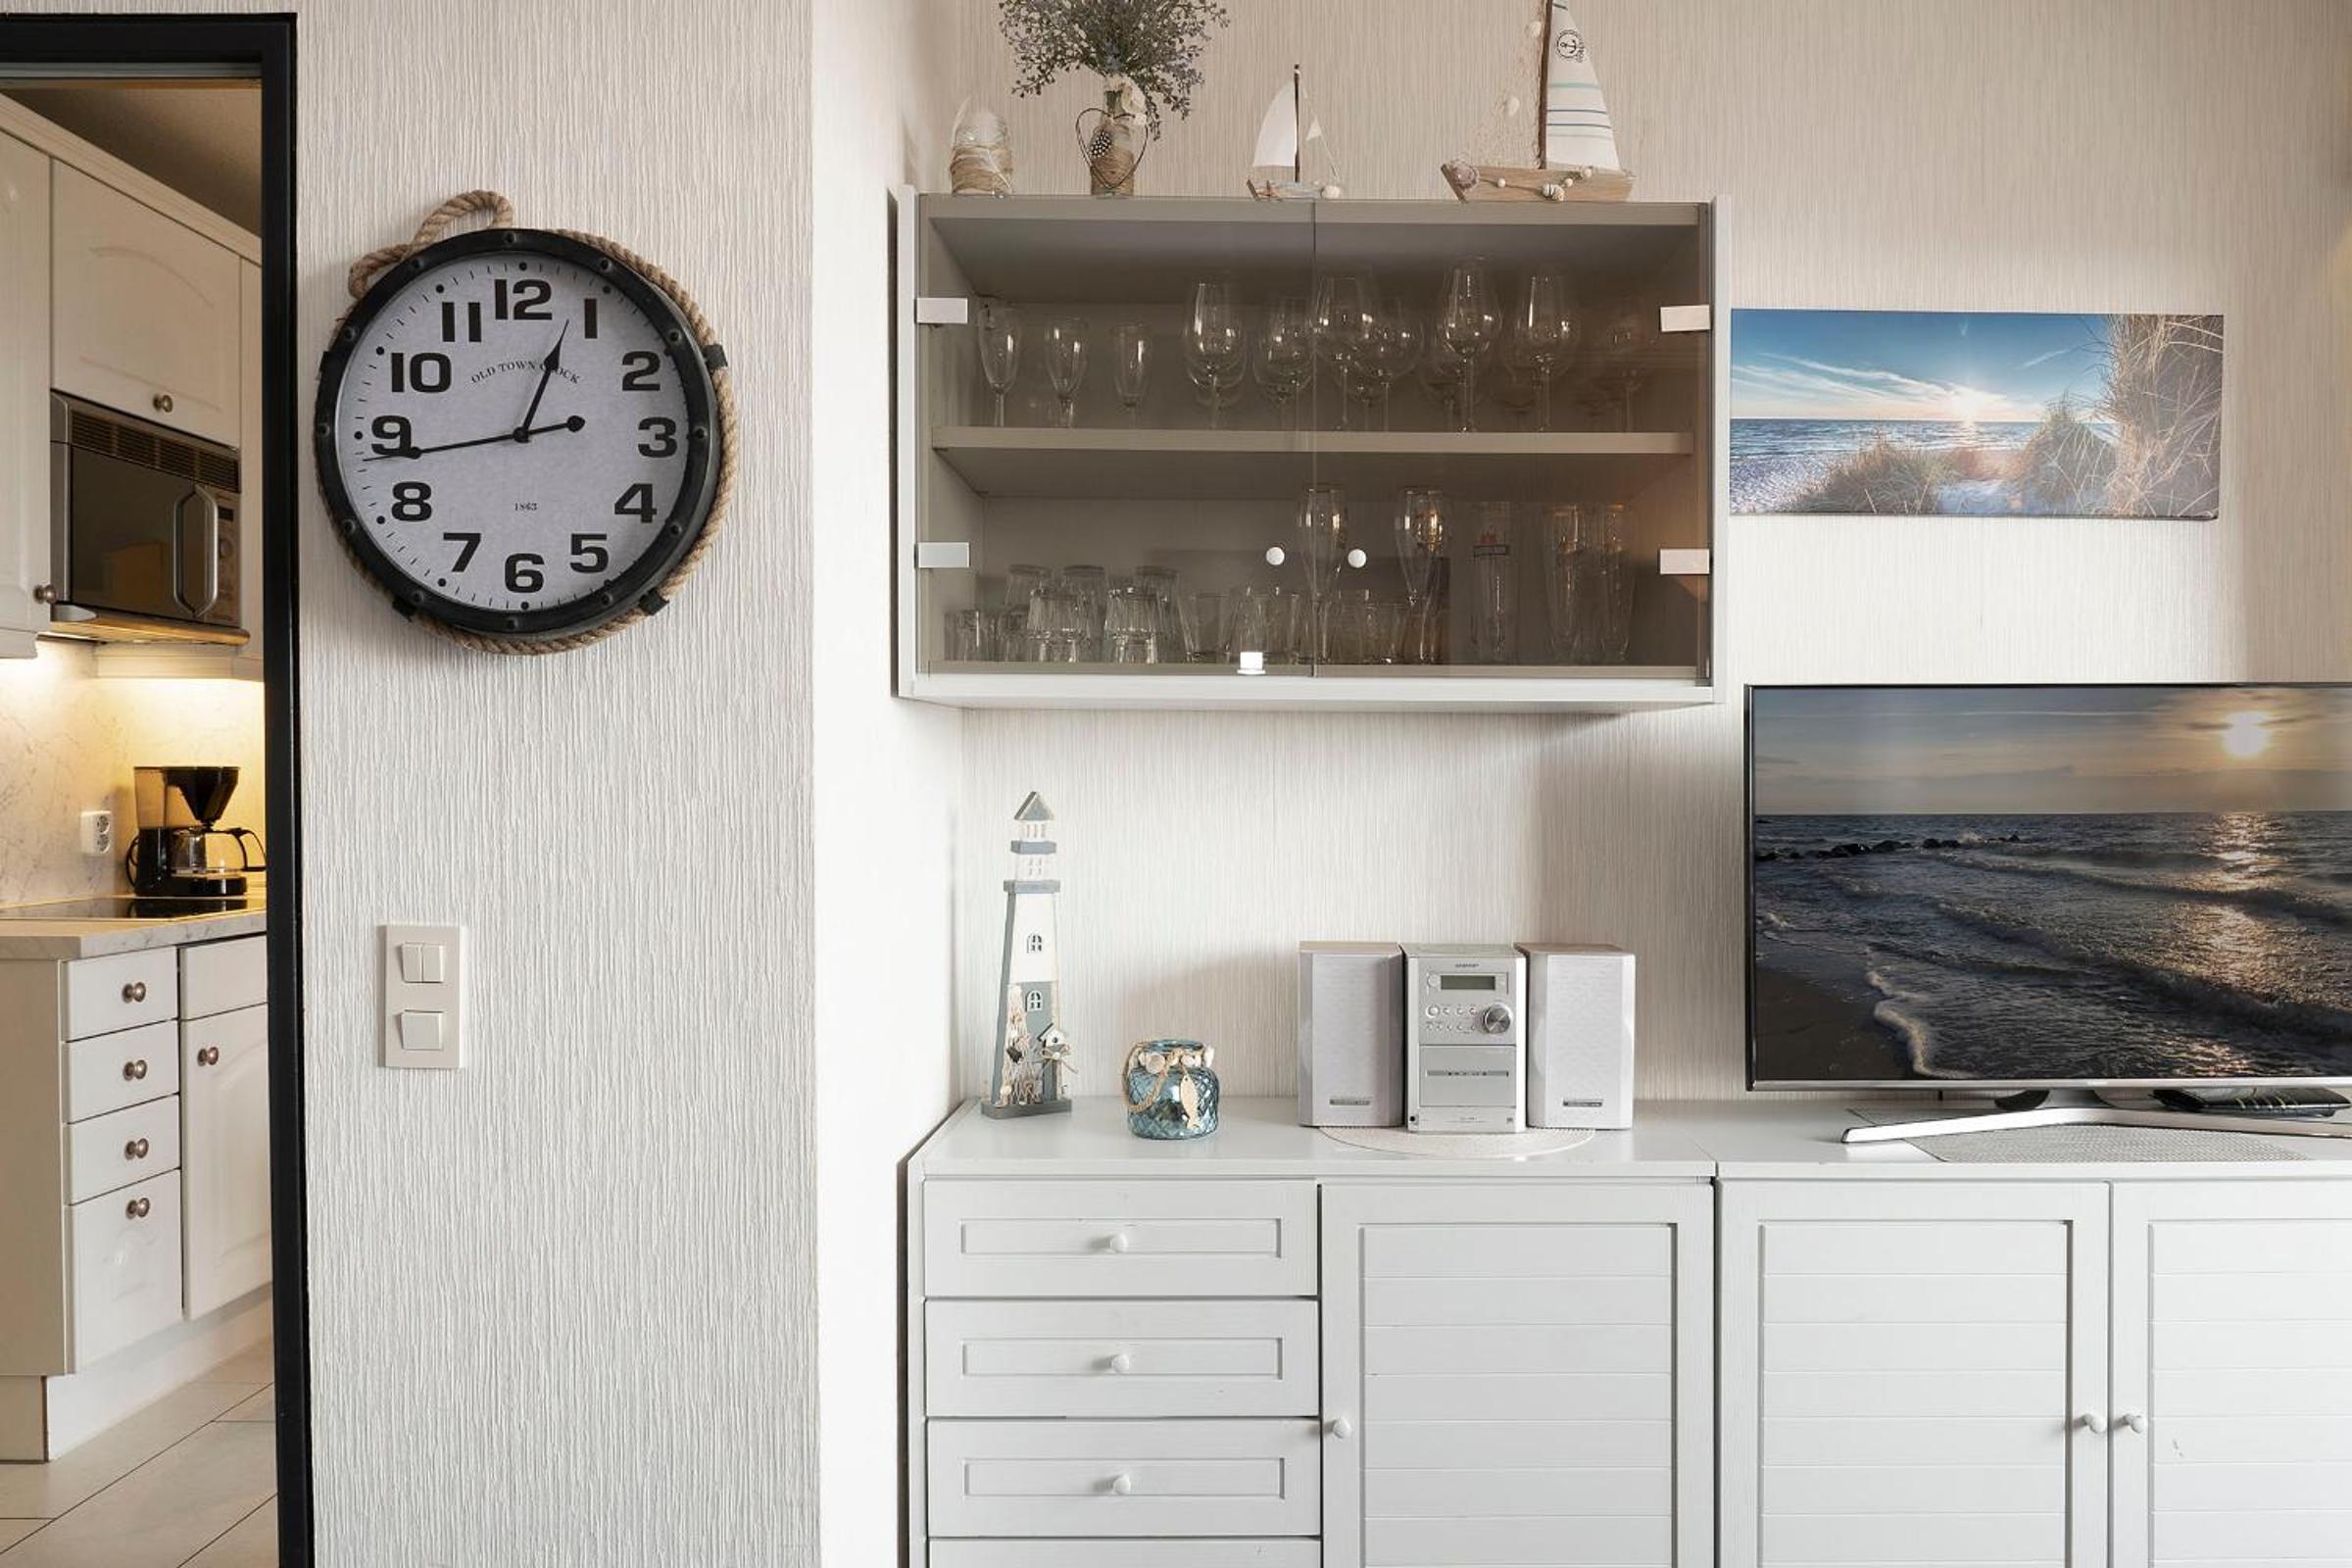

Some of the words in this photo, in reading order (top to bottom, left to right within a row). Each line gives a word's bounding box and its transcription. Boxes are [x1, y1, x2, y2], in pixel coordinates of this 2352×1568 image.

[494, 278, 553, 320] 12
[584, 298, 599, 339] 1
[441, 301, 482, 342] 11
[391, 352, 452, 393] 10
[471, 366, 496, 384] OLD
[498, 360, 536, 372] TOWN
[539, 362, 580, 384] COCK
[621, 351, 662, 391] 2
[370, 416, 413, 456] 9
[638, 416, 678, 459] 3
[391, 481, 432, 521] 8
[613, 483, 658, 523] 4
[442, 532, 481, 573] 7
[569, 533, 610, 573] 5
[504, 553, 545, 594] 6
